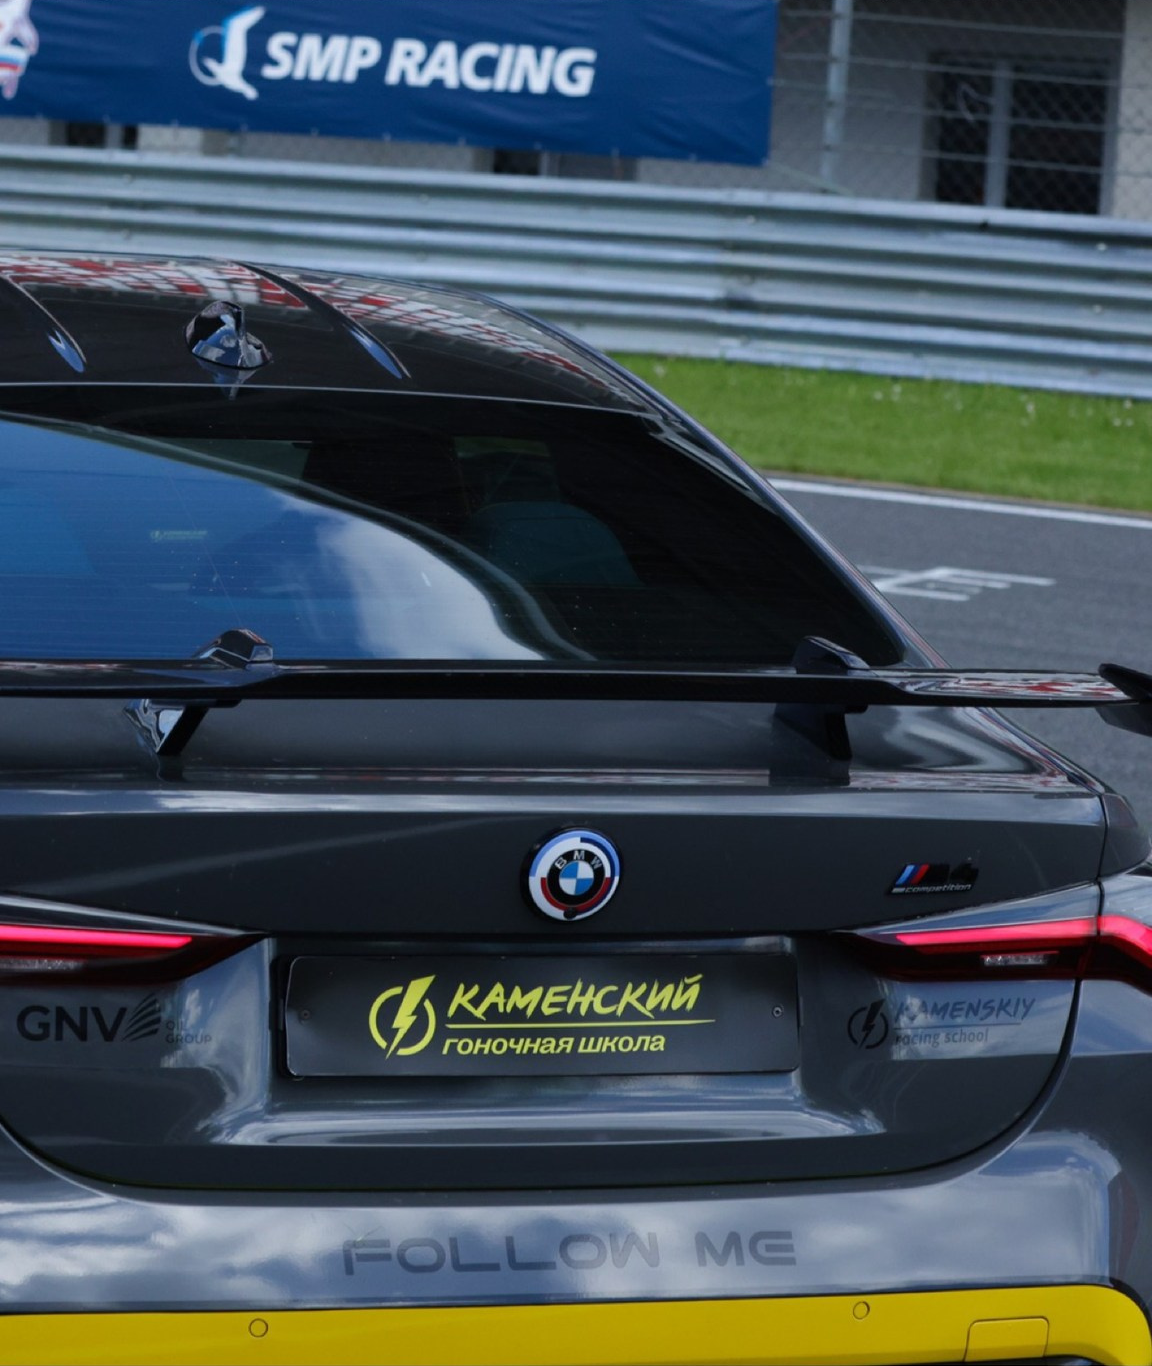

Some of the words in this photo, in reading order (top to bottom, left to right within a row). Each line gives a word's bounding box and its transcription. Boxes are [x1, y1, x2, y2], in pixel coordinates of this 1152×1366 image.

[261, 31, 383, 82] SMP
[384, 37, 597, 97] RACING
[554, 850, 603, 870] BMW
[447, 973, 704, 1021] КАМЕНСКИЙ
[16, 1005, 128, 1042] GNV
[165, 1035, 213, 1045] GROUP
[442, 1037, 575, 1056] гоночная
[577, 1035, 666, 1053] школа
[895, 1032, 940, 1049] racing
[944, 1028, 989, 1044] school
[342, 1230, 661, 1276] FOLLOW
[693, 1230, 797, 1267] ME
